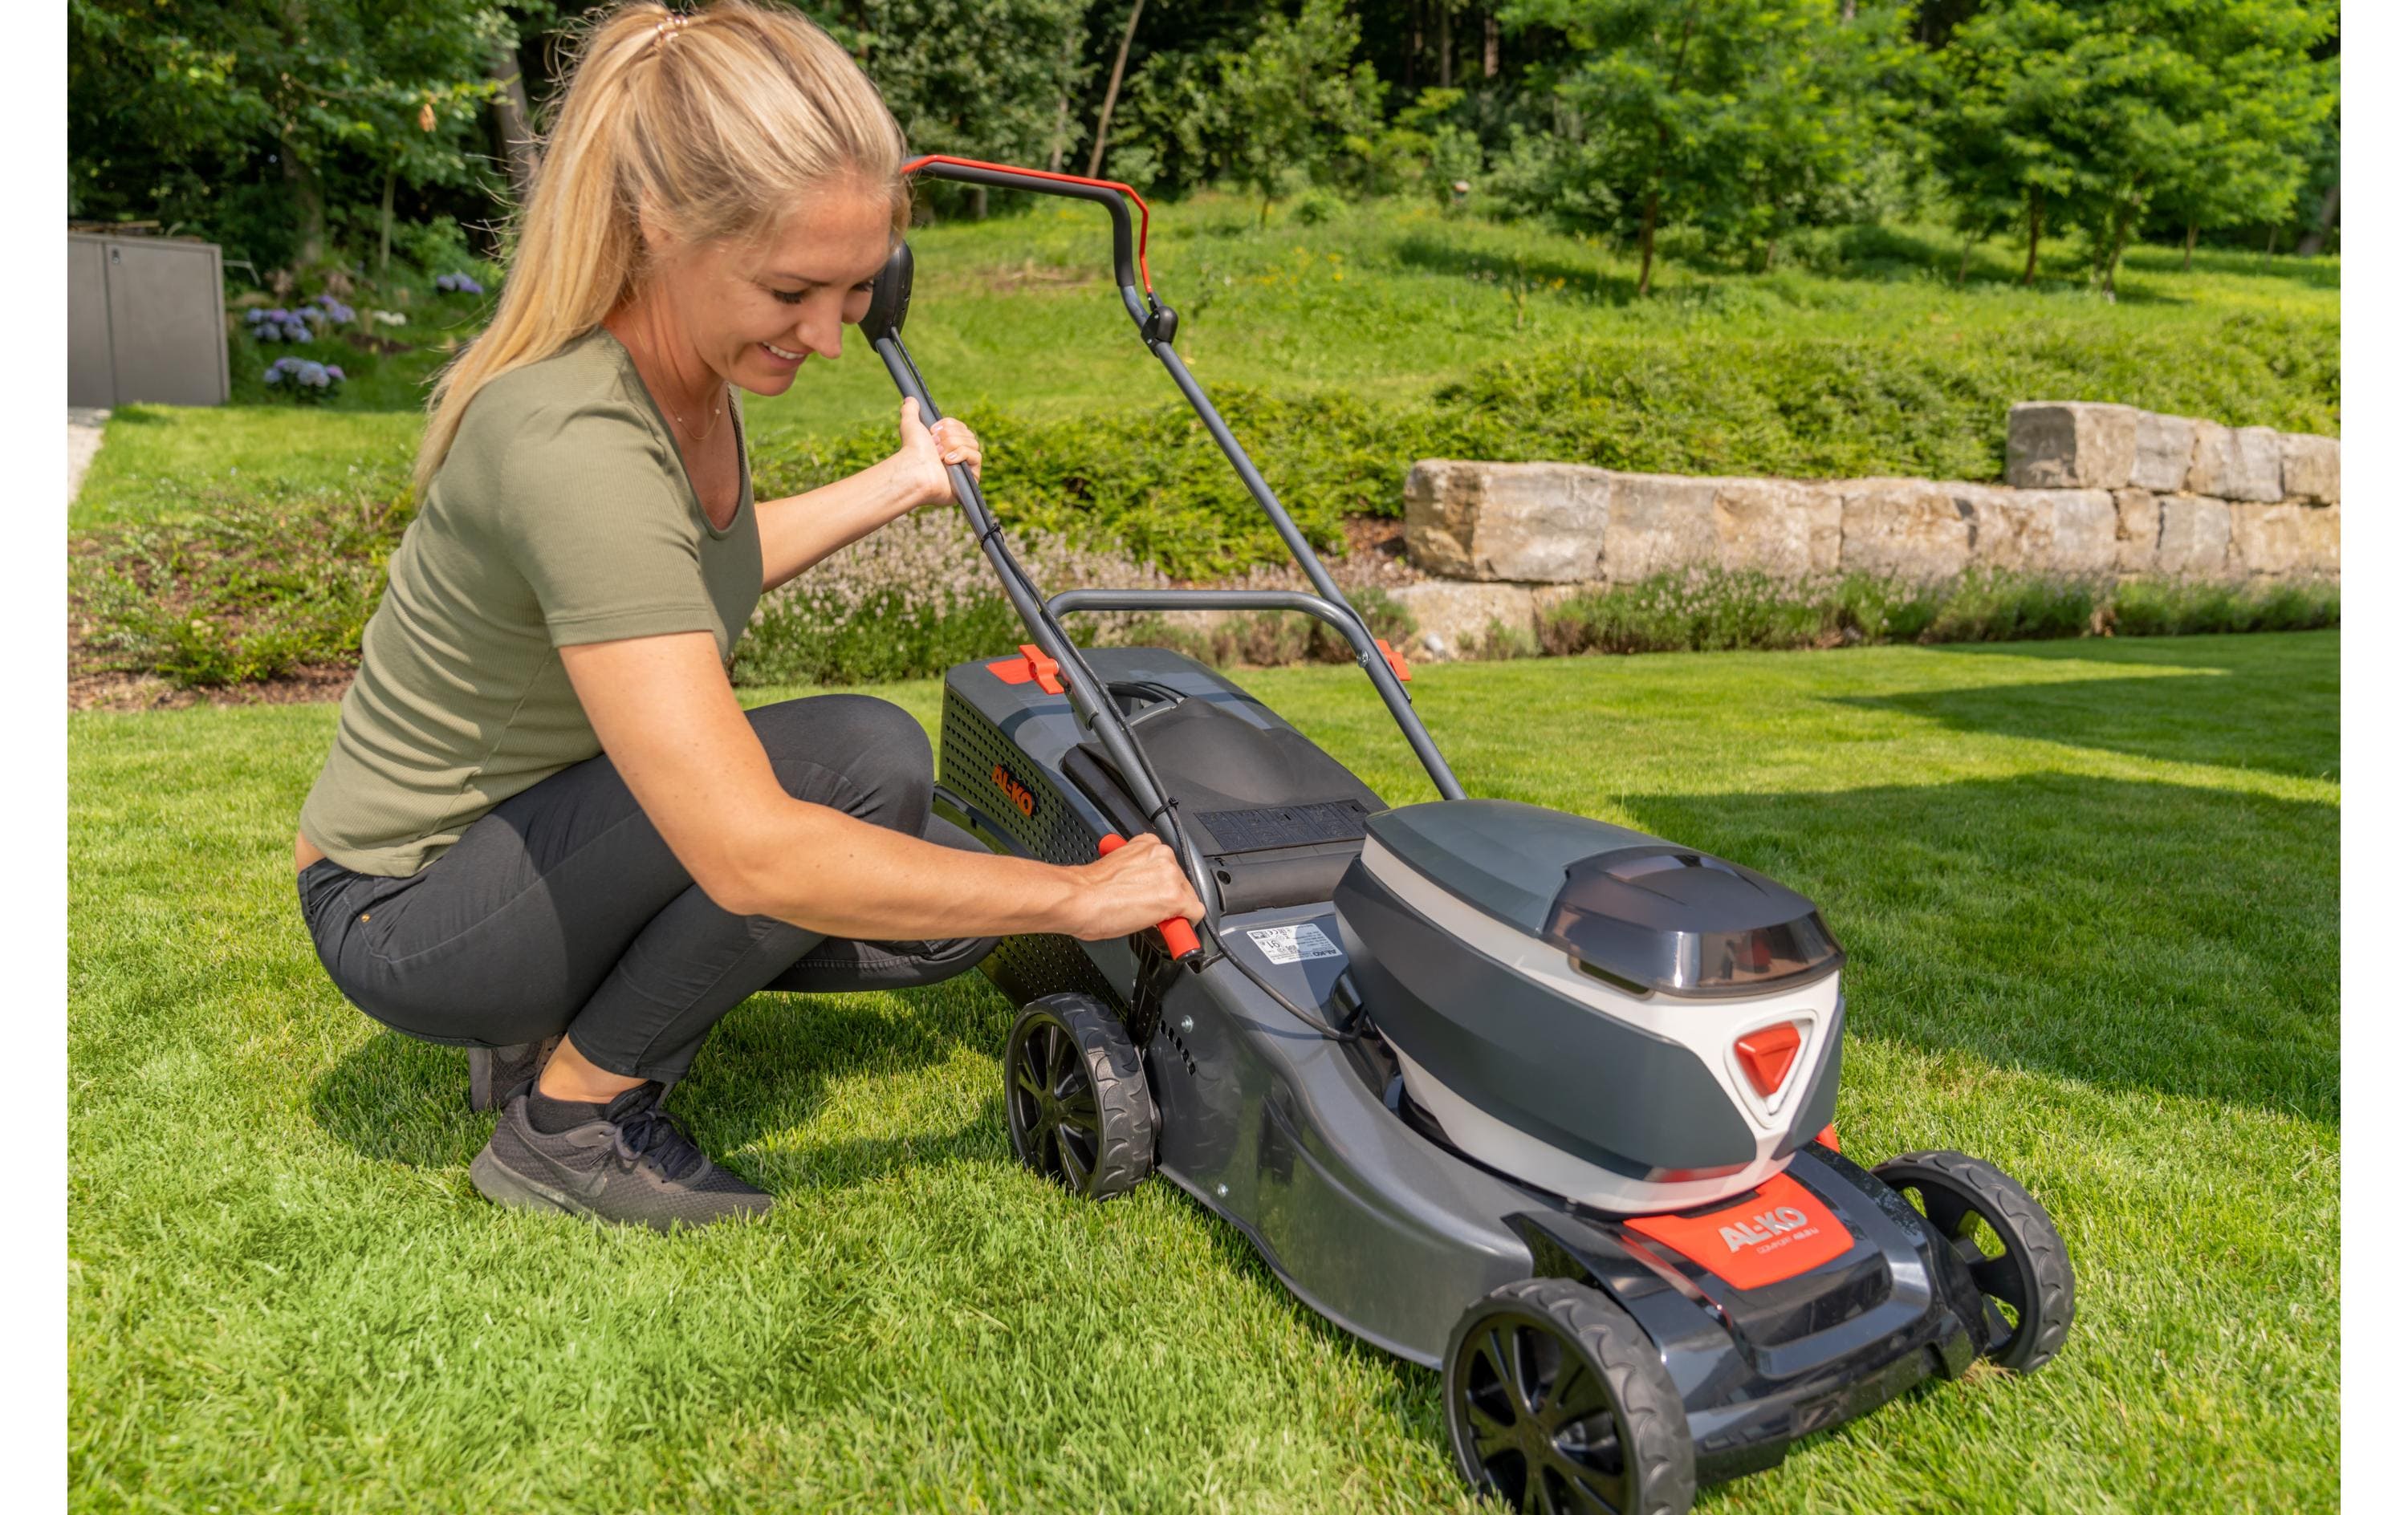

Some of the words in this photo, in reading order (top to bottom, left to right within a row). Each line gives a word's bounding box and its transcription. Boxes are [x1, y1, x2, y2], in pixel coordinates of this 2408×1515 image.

[991, 764, 1033, 817] AL-KO
[1266, 940, 1280, 949] 91
[1312, 948, 1337, 957] AL-KO
[1718, 1206, 1808, 1253] AL-KO
